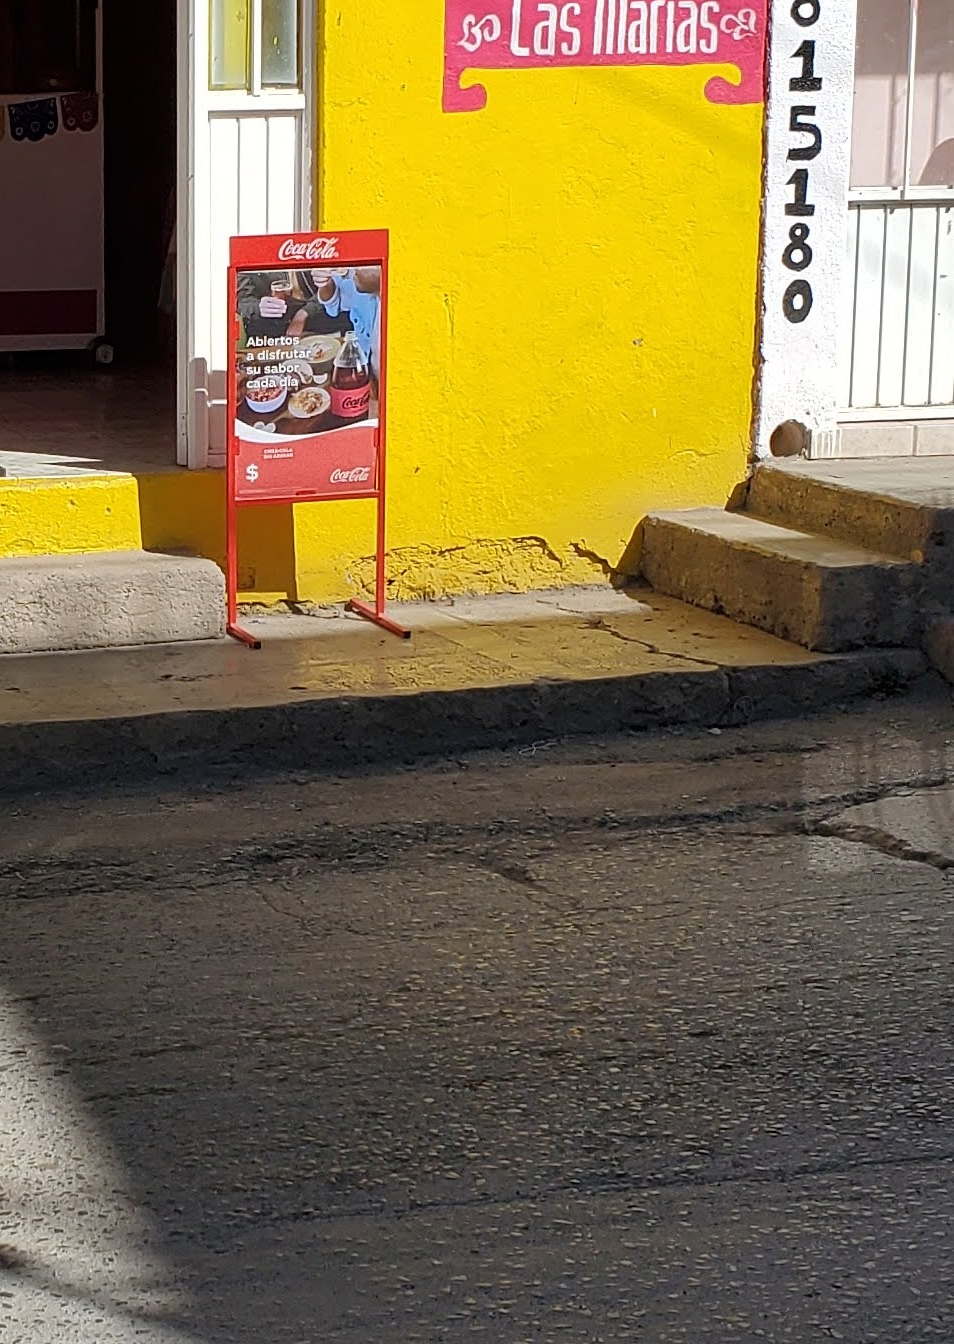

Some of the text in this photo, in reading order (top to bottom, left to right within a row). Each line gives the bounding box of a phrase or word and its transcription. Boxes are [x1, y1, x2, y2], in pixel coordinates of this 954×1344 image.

[278, 237, 339, 261] Coca-Cola
[246, 336, 300, 348] Abiertos
[246, 349, 312, 362] a disfrutar
[246, 363, 300, 375] su sabor
[246, 378, 277, 389] cada
[329, 466, 371, 484] Coca-Cola
